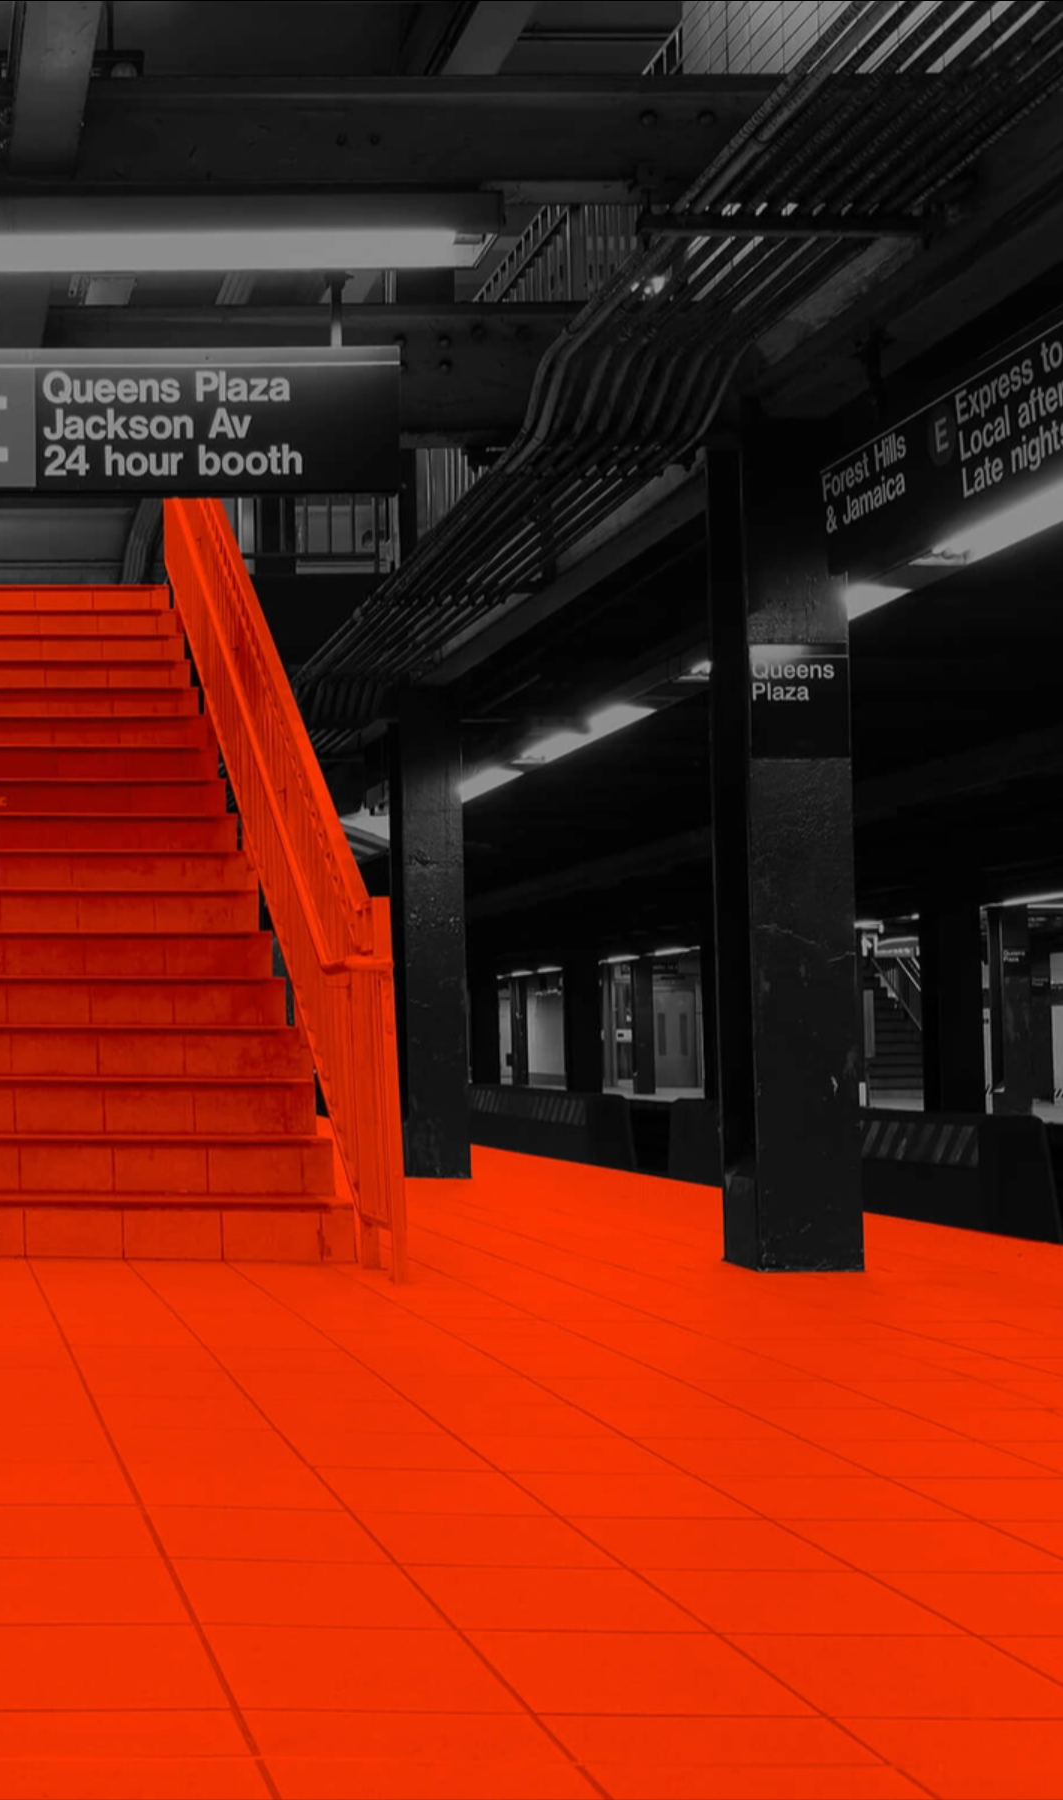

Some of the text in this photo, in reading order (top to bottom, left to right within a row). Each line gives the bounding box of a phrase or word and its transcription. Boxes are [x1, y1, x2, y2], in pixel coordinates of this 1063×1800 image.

[42, 370, 291, 405] Queens Plaza
[954, 340, 1063, 426] Express to
[43, 407, 253, 441] Jackson Av
[934, 416, 950, 454] E
[957, 403, 1012, 463] Local
[43, 443, 304, 477] 24 hour booth
[821, 432, 907, 503] Forest Hills
[961, 456, 1005, 499] Late
[825, 471, 907, 535] & Jamaica
[752, 662, 835, 680] Queens
[752, 682, 810, 701] Plaza
